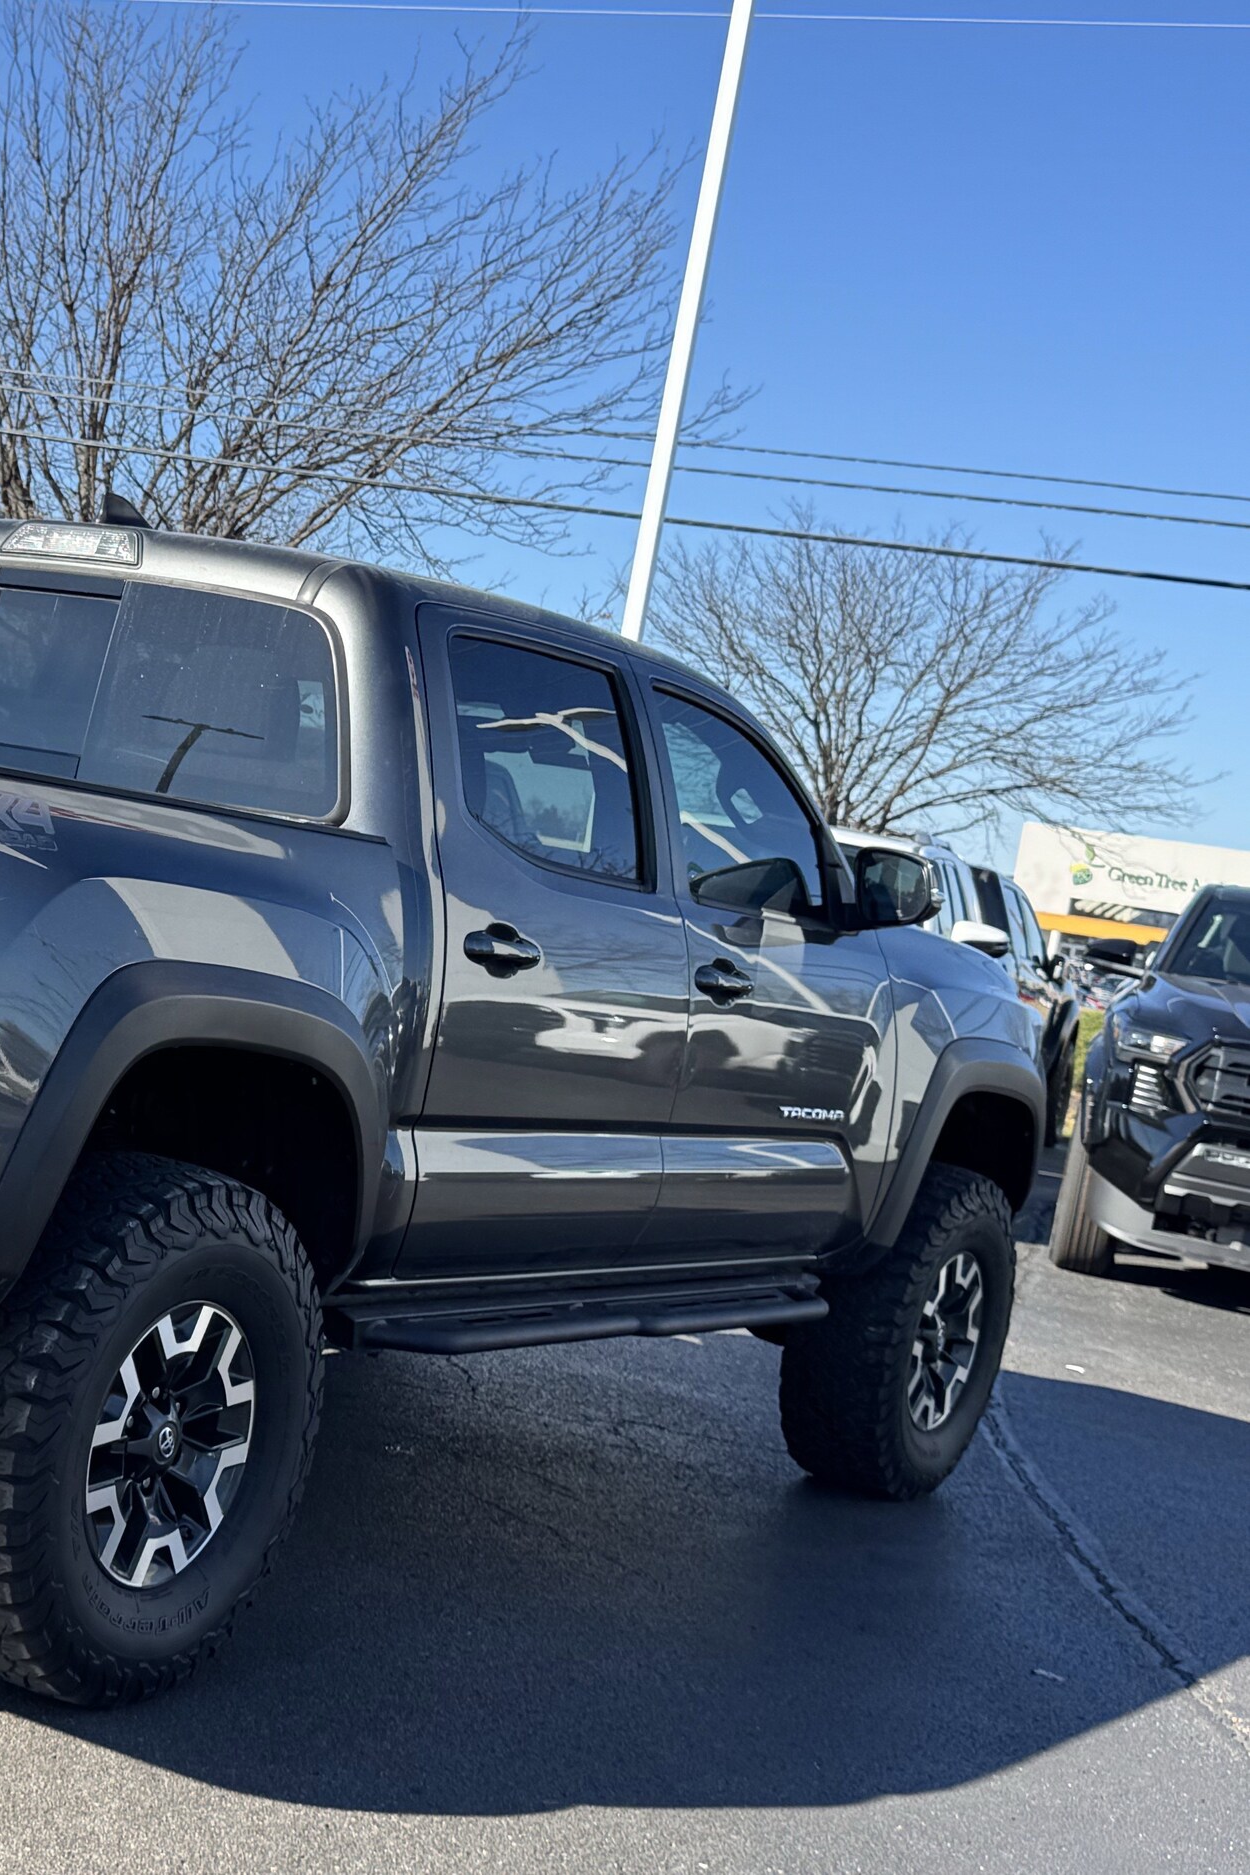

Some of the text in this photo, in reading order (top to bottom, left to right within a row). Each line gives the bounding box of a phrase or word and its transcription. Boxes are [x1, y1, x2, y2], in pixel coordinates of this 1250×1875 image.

[1107, 866, 1154, 887] Green
[1155, 871, 1188, 892] Tree
[778, 1105, 846, 1122] TACOMA
